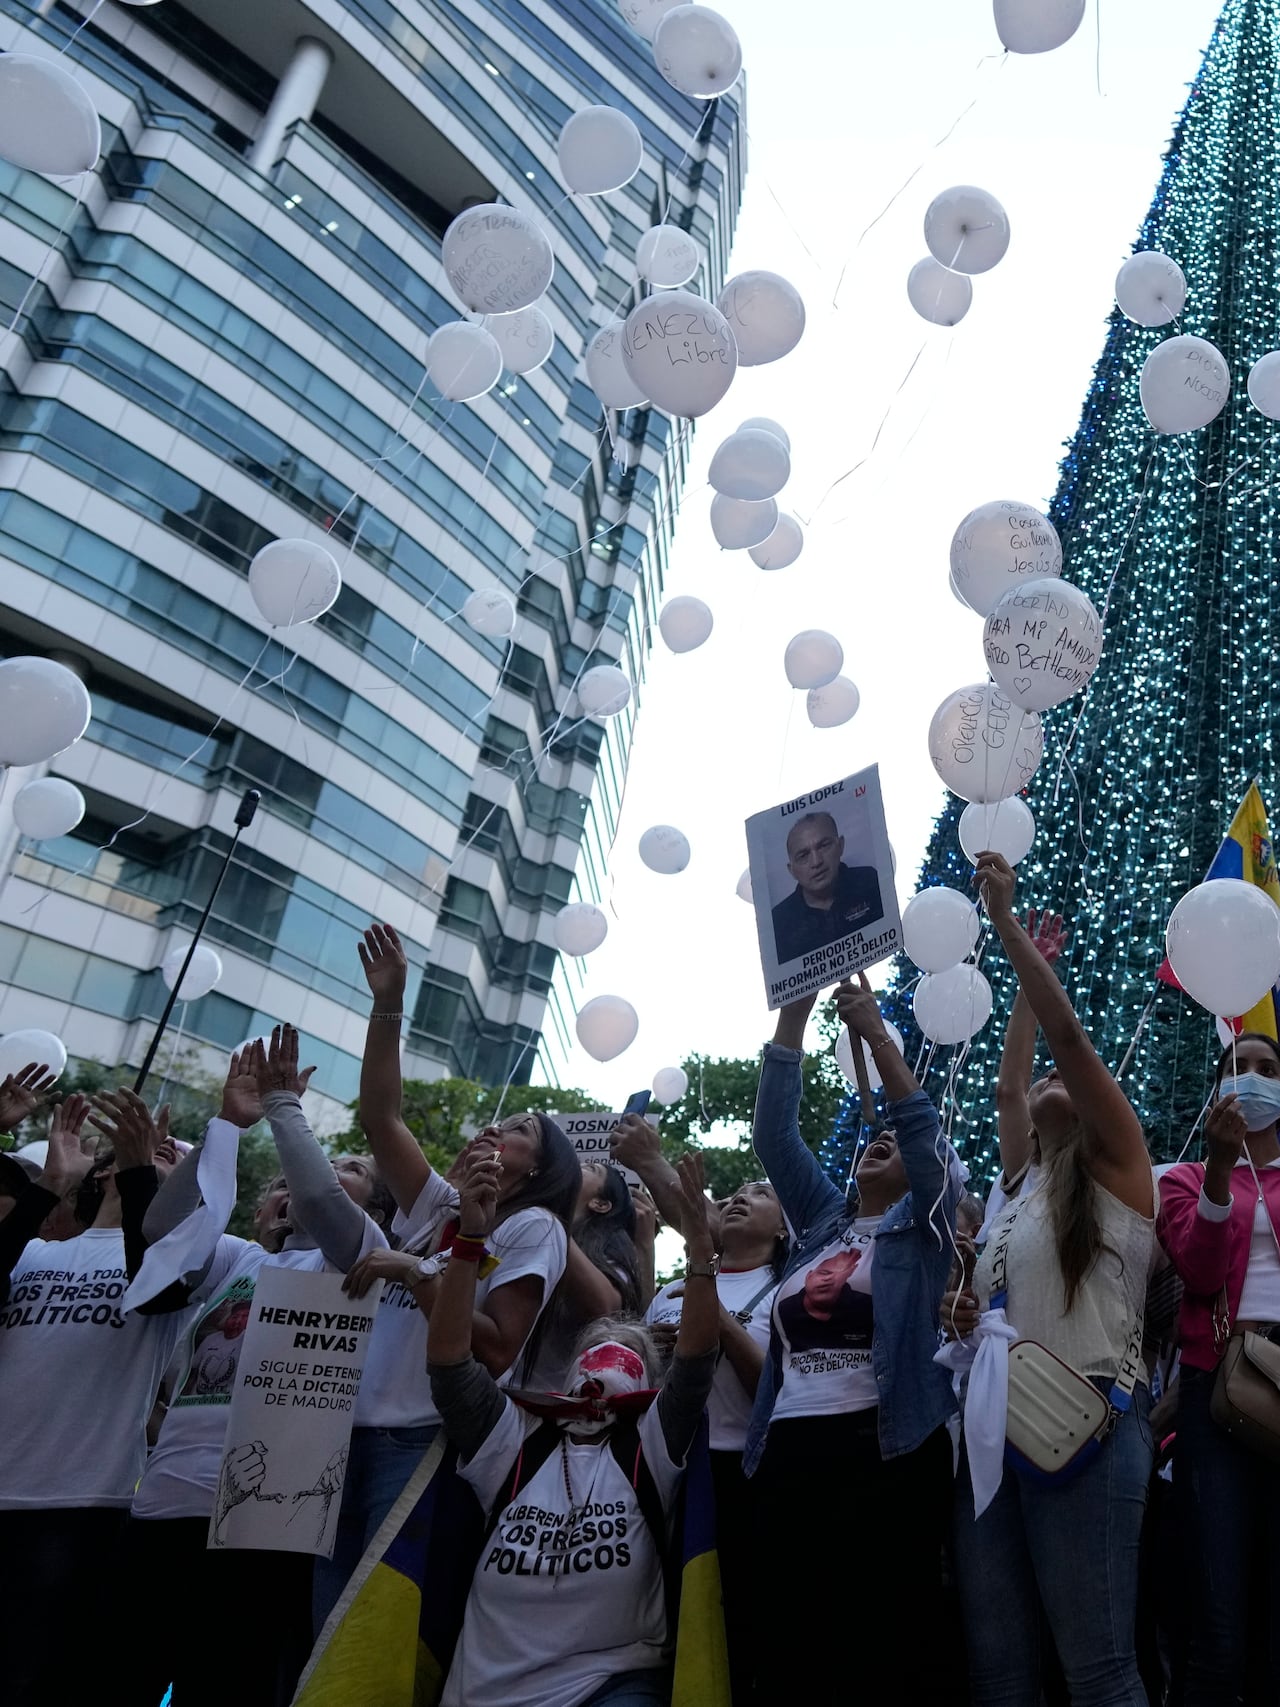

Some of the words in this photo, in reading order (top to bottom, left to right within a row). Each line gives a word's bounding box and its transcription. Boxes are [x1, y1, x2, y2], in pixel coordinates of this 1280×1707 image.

[666, 340, 729, 366] Libre
[1007, 551, 1049, 574] Jesús
[1055, 626, 1095, 665] AMADO
[781, 798, 807, 817] LUIS
[808, 780, 845, 808] LOPEZ
[854, 785, 867, 798] LV
[802, 931, 864, 969] PERIODISTA
[770, 962, 828, 996] INFORMAR
[829, 954, 845, 971] NO
[847, 946, 860, 961] ES
[862, 928, 897, 955] DELITO
[566, 1119, 620, 1133] JOSNA
[575, 1138, 609, 1151] ADU
[12, 1270, 76, 1285] IBEREN
[76, 1272, 89, 1283] A
[258, 1306, 374, 1334] HENRYBERT
[293, 1332, 358, 1353] RIVAS
[259, 1360, 309, 1376] SIGUE
[312, 1364, 362, 1381] DETENID
[813, 1363, 825, 1374] ES
[244, 1375, 274, 1389] POR
[278, 1378, 298, 1391] LA
[264, 1393, 287, 1406] DE
[292, 1395, 352, 1412] MADURO
[506, 1504, 565, 1529] LIBEREN
[538, 1517, 627, 1551] PRESOS
[484, 1542, 632, 1576] POLÍTICOS
